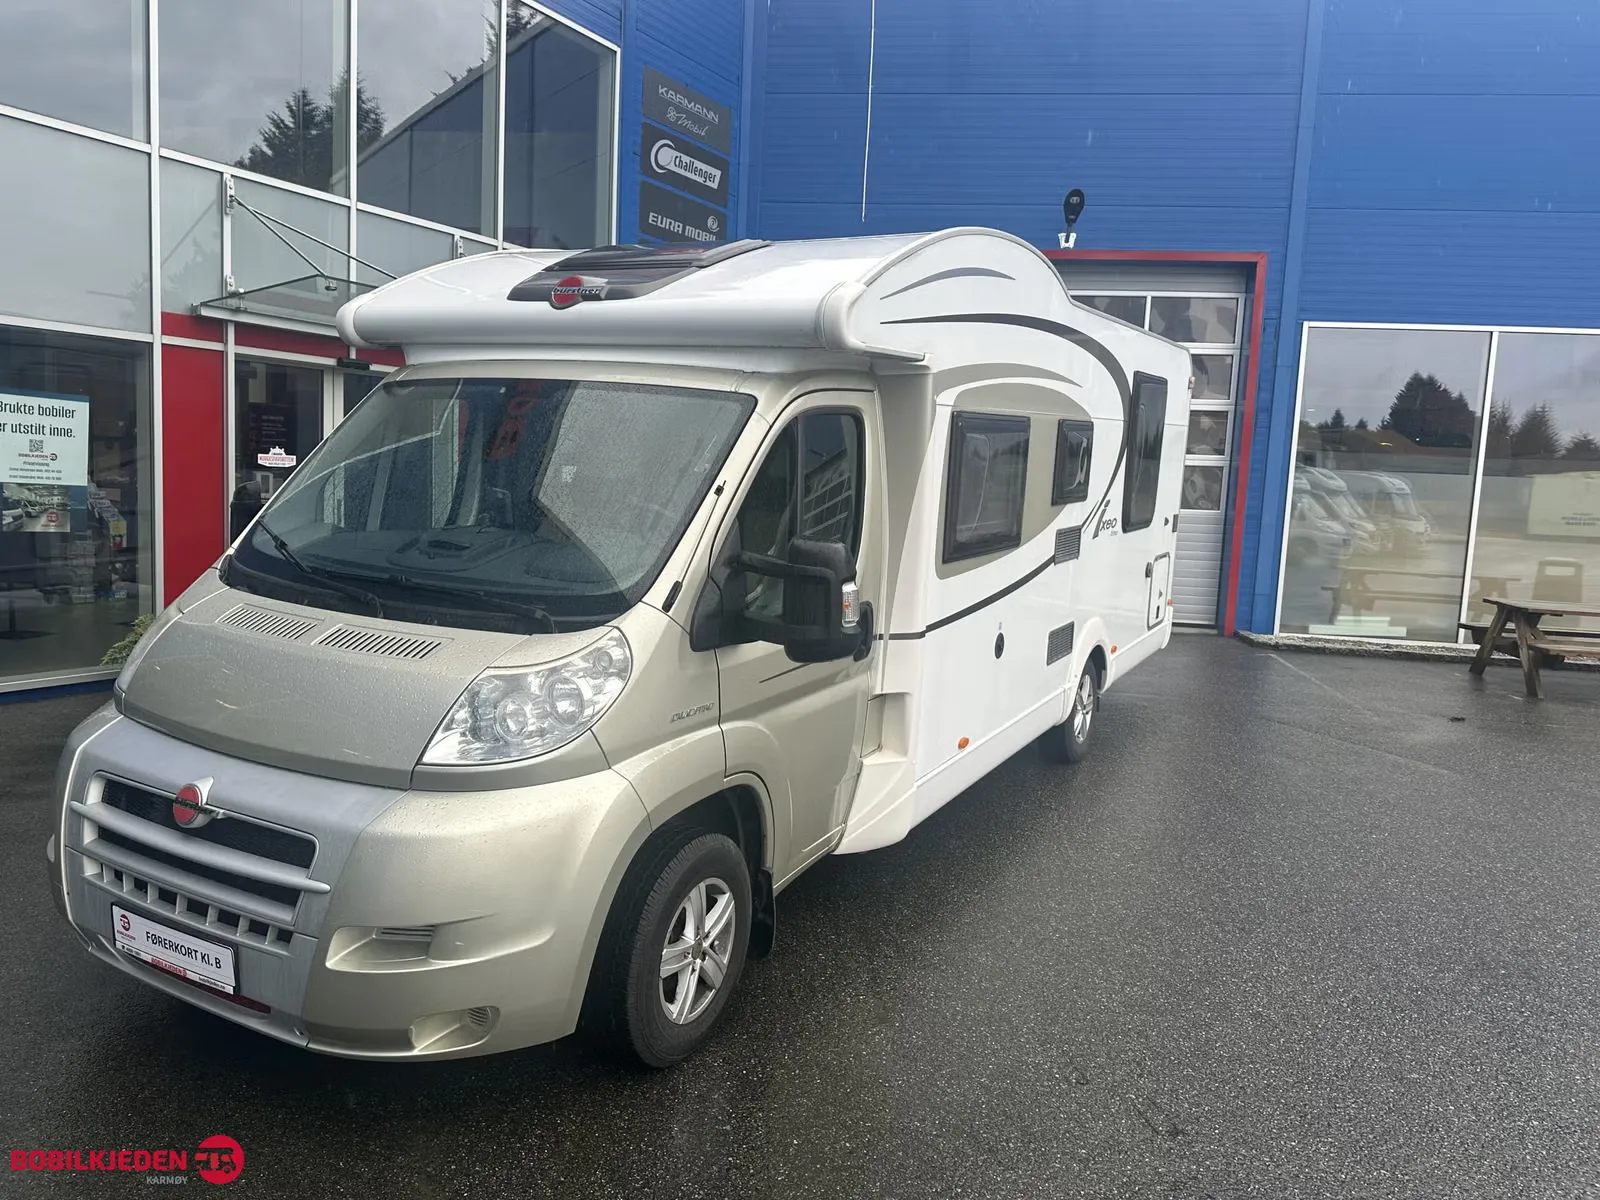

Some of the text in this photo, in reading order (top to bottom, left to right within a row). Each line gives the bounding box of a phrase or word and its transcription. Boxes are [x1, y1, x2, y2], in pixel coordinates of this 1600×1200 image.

[658, 84, 719, 123] KARMANN
[675, 113, 709, 136] Mobil
[673, 155, 717, 184] Challenger
[648, 212, 683, 234] EURA
[38, 403, 77, 419] bobiler
[11, 422, 46, 436] utstilt
[49, 424, 76, 438] inne.
[145, 930, 199, 961] FØRERKORT
[214, 956, 222, 969] B
